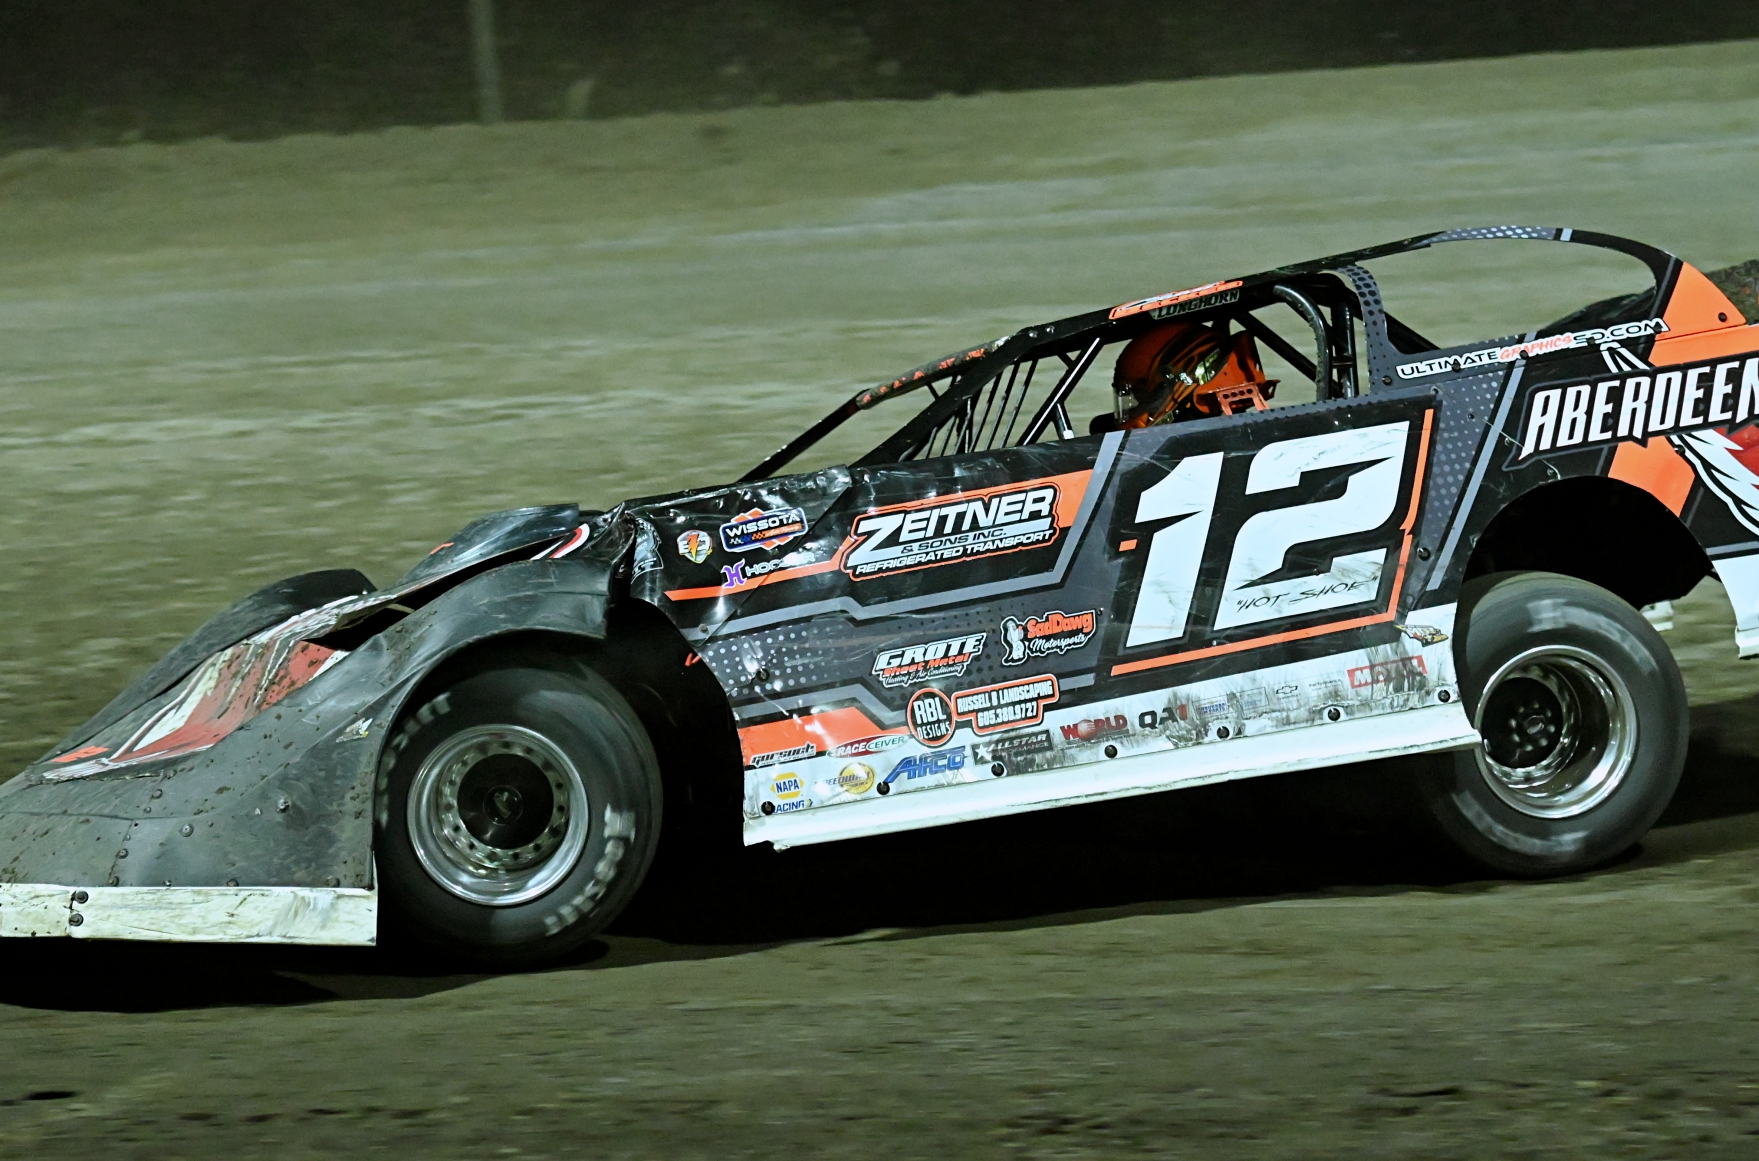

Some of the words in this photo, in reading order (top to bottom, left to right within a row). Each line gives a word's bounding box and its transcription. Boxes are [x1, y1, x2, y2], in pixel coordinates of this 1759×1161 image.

[1156, 290, 1240, 318] LONGHORN
[725, 512, 801, 537] WISSOTA
[847, 488, 1056, 567] ZEITNER
[1125, 420, 1410, 648] 12
[855, 546, 964, 575] REFRIGERATED
[965, 529, 1054, 555] TRANSPORT
[900, 543, 914, 555] &
[917, 534, 969, 552] SONS
[972, 528, 1007, 542] INC.
[745, 551, 816, 577] HOOR
[1027, 612, 1094, 639] SadDawg
[875, 634, 983, 671] GROTE
[1030, 634, 1087, 654] Motorsports
[882, 661, 925, 678] Sheet
[926, 653, 971, 669] Metal
[885, 673, 909, 685] Heating
[916, 670, 927, 679] Air
[1354, 658, 1423, 686] MOTL
[957, 695, 991, 714] RUSSELL
[999, 680, 1054, 705] LANDSCAPING
[913, 697, 947, 726] RBL
[977, 701, 1038, 728] 605.380.9727
[1138, 703, 1188, 730] QA1
[916, 720, 951, 741] DESIGNS
[1059, 714, 1128, 741] WORLD
[986, 733, 1049, 752] ALLSTAR
[998, 742, 1049, 757] ORMANCE
[884, 745, 966, 783] AFCO
[775, 778, 800, 794] NAPA
[815, 771, 871, 786] EEDWY
